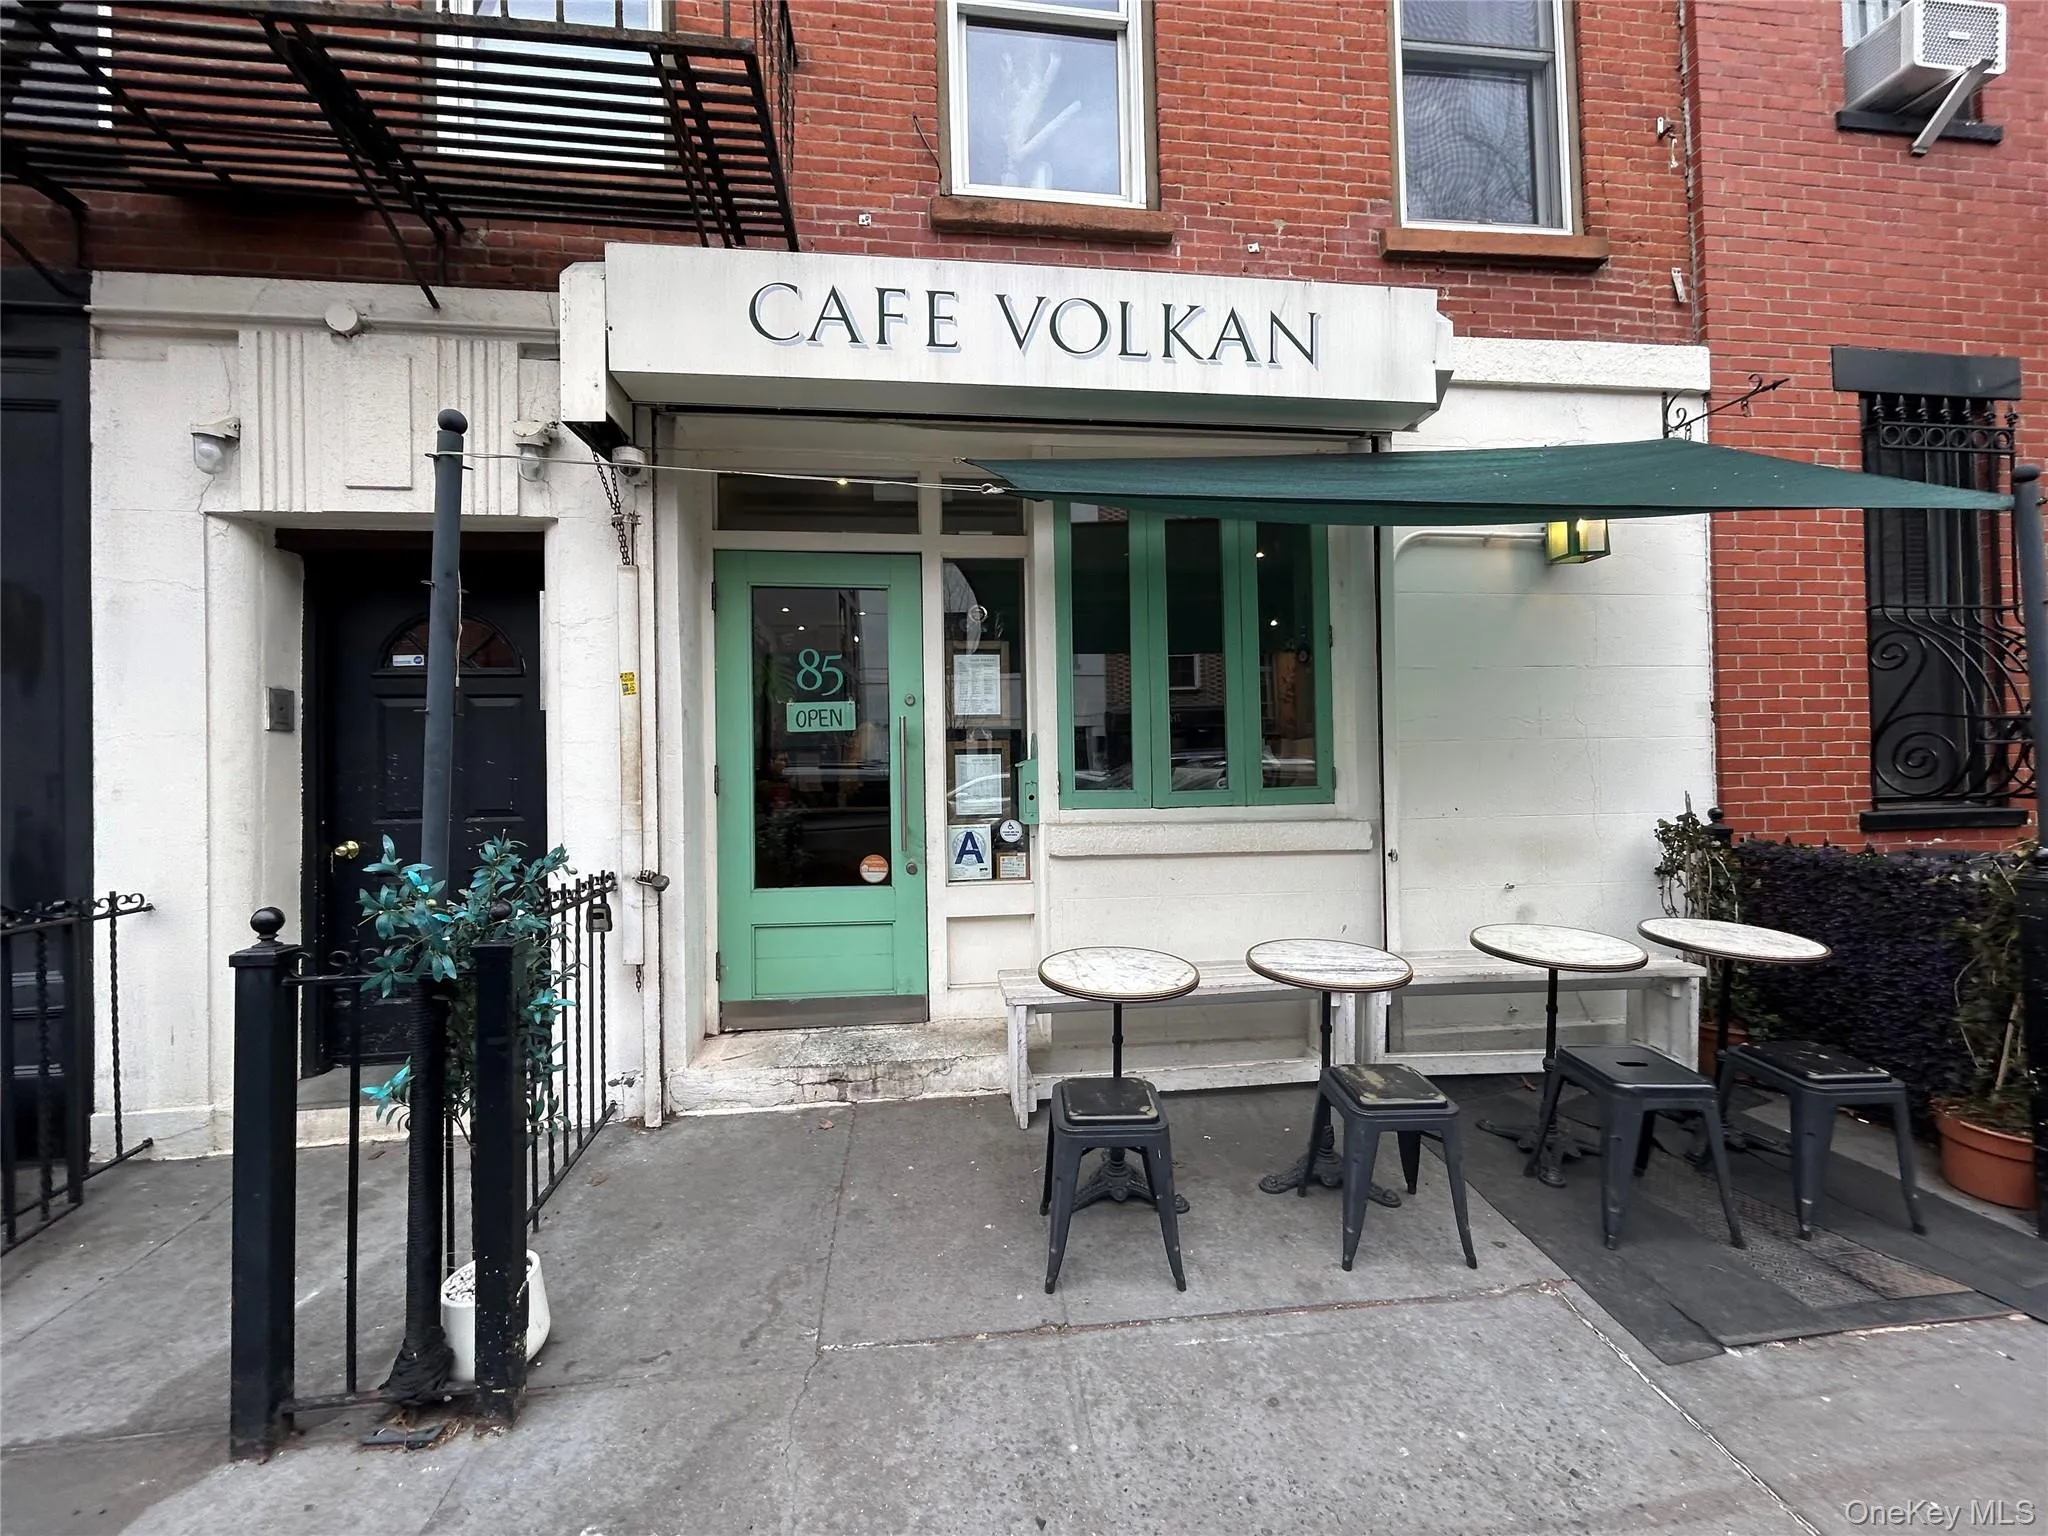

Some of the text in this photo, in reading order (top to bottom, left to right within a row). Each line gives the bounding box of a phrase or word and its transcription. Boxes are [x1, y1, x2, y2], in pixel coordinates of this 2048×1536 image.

[749, 282, 1320, 371] CAFE VOLKAN
[796, 648, 844, 697] 85
[795, 708, 843, 728] OPEN
[954, 831, 985, 865] A
